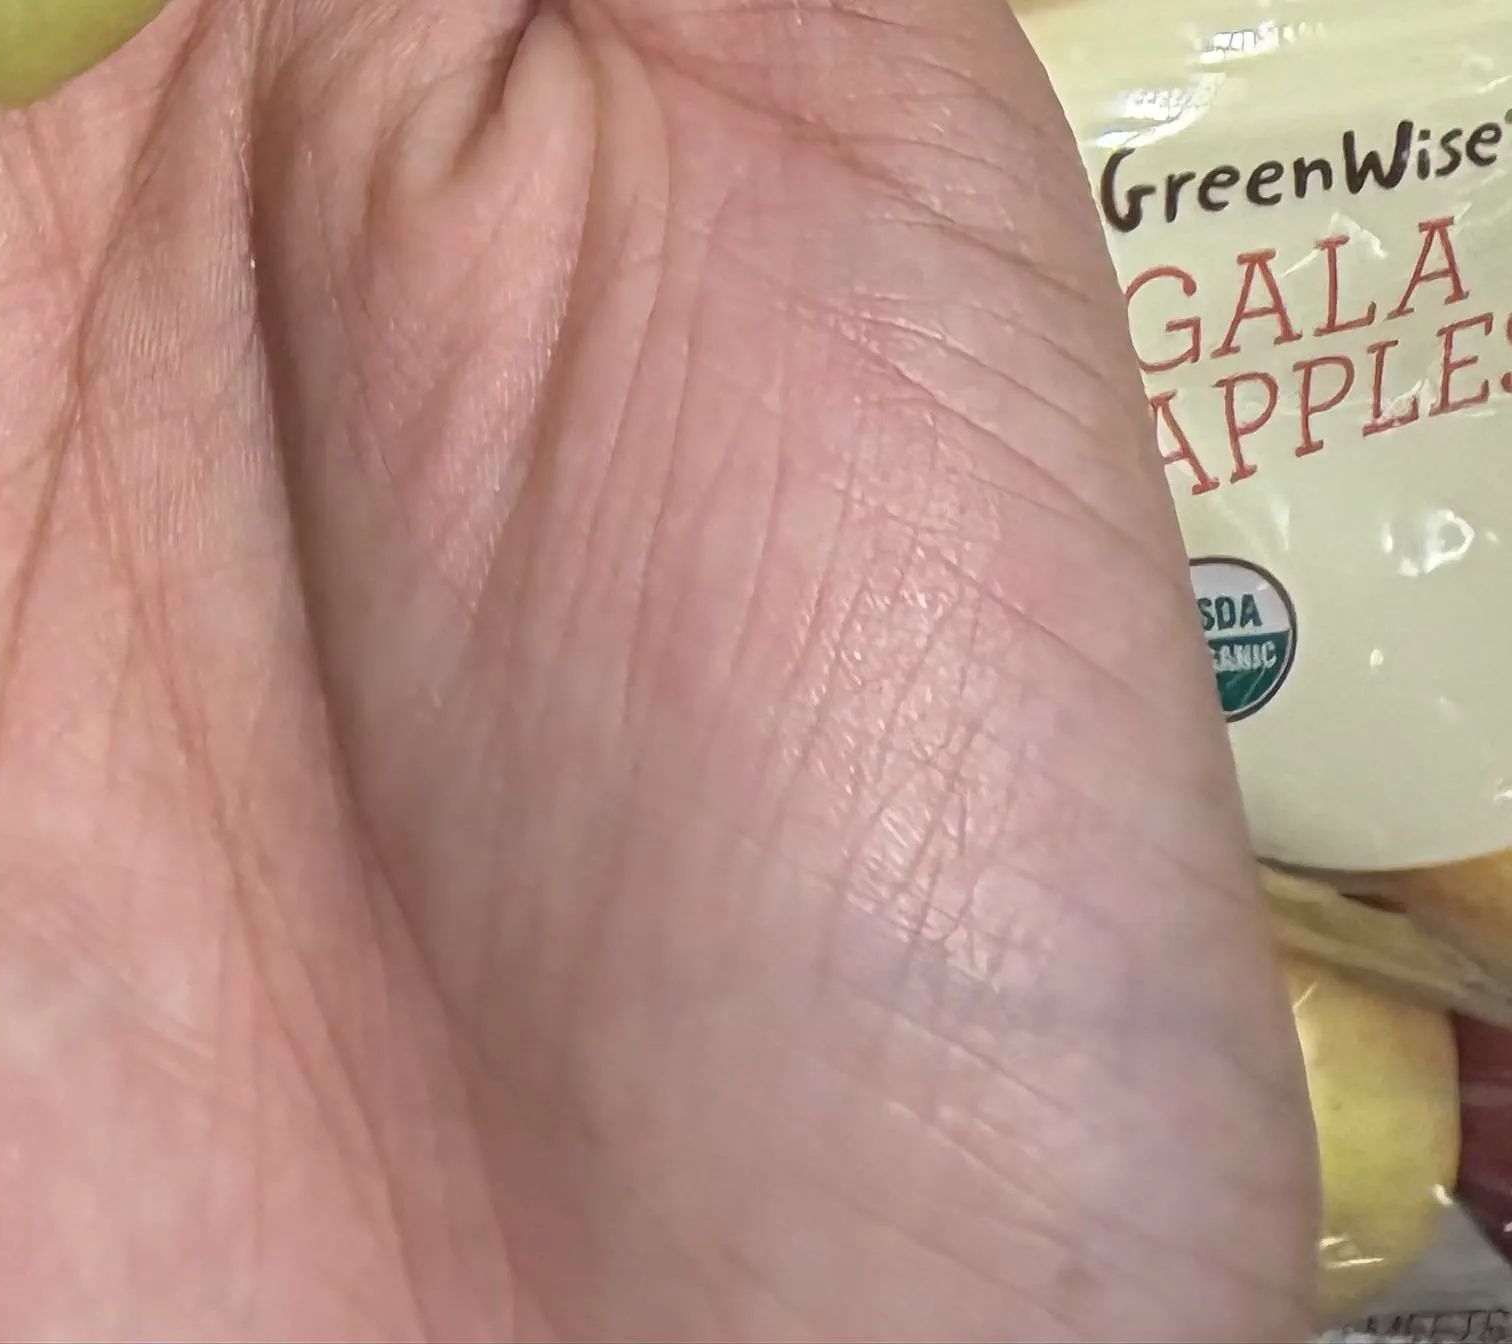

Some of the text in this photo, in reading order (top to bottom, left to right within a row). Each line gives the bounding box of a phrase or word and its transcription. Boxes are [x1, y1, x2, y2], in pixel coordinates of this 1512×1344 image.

[1100, 119, 1503, 233] GreenWise
[1124, 215, 1470, 374] GALA
[1149, 311, 1512, 496] APPLE
